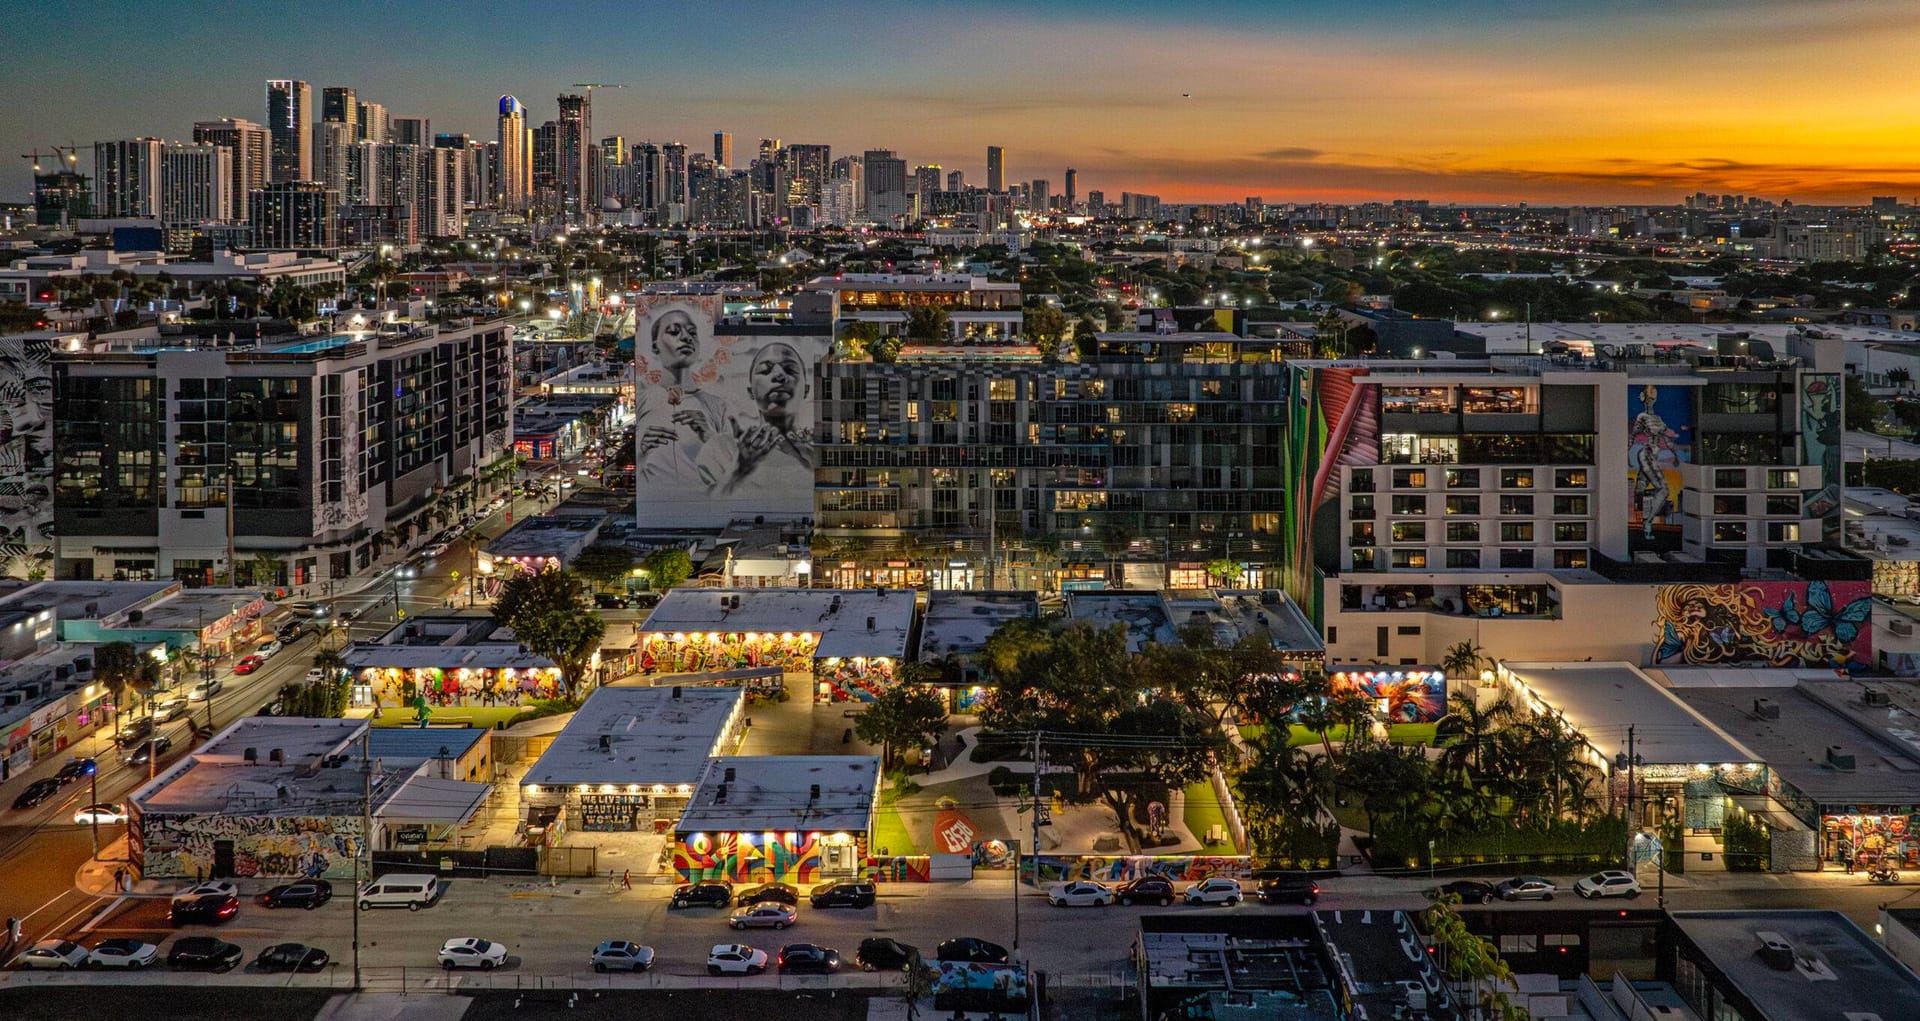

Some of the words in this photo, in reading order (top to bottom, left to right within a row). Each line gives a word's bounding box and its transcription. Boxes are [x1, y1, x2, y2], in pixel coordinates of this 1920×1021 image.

[582, 795, 596, 804] WE
[599, 795, 620, 804] LIVE
[624, 795, 635, 804] IN
[638, 795, 645, 804] A
[582, 804, 634, 814] BEAUTIFUL
[586, 815, 630, 824] WORLD
[941, 819, 974, 853] RESET
